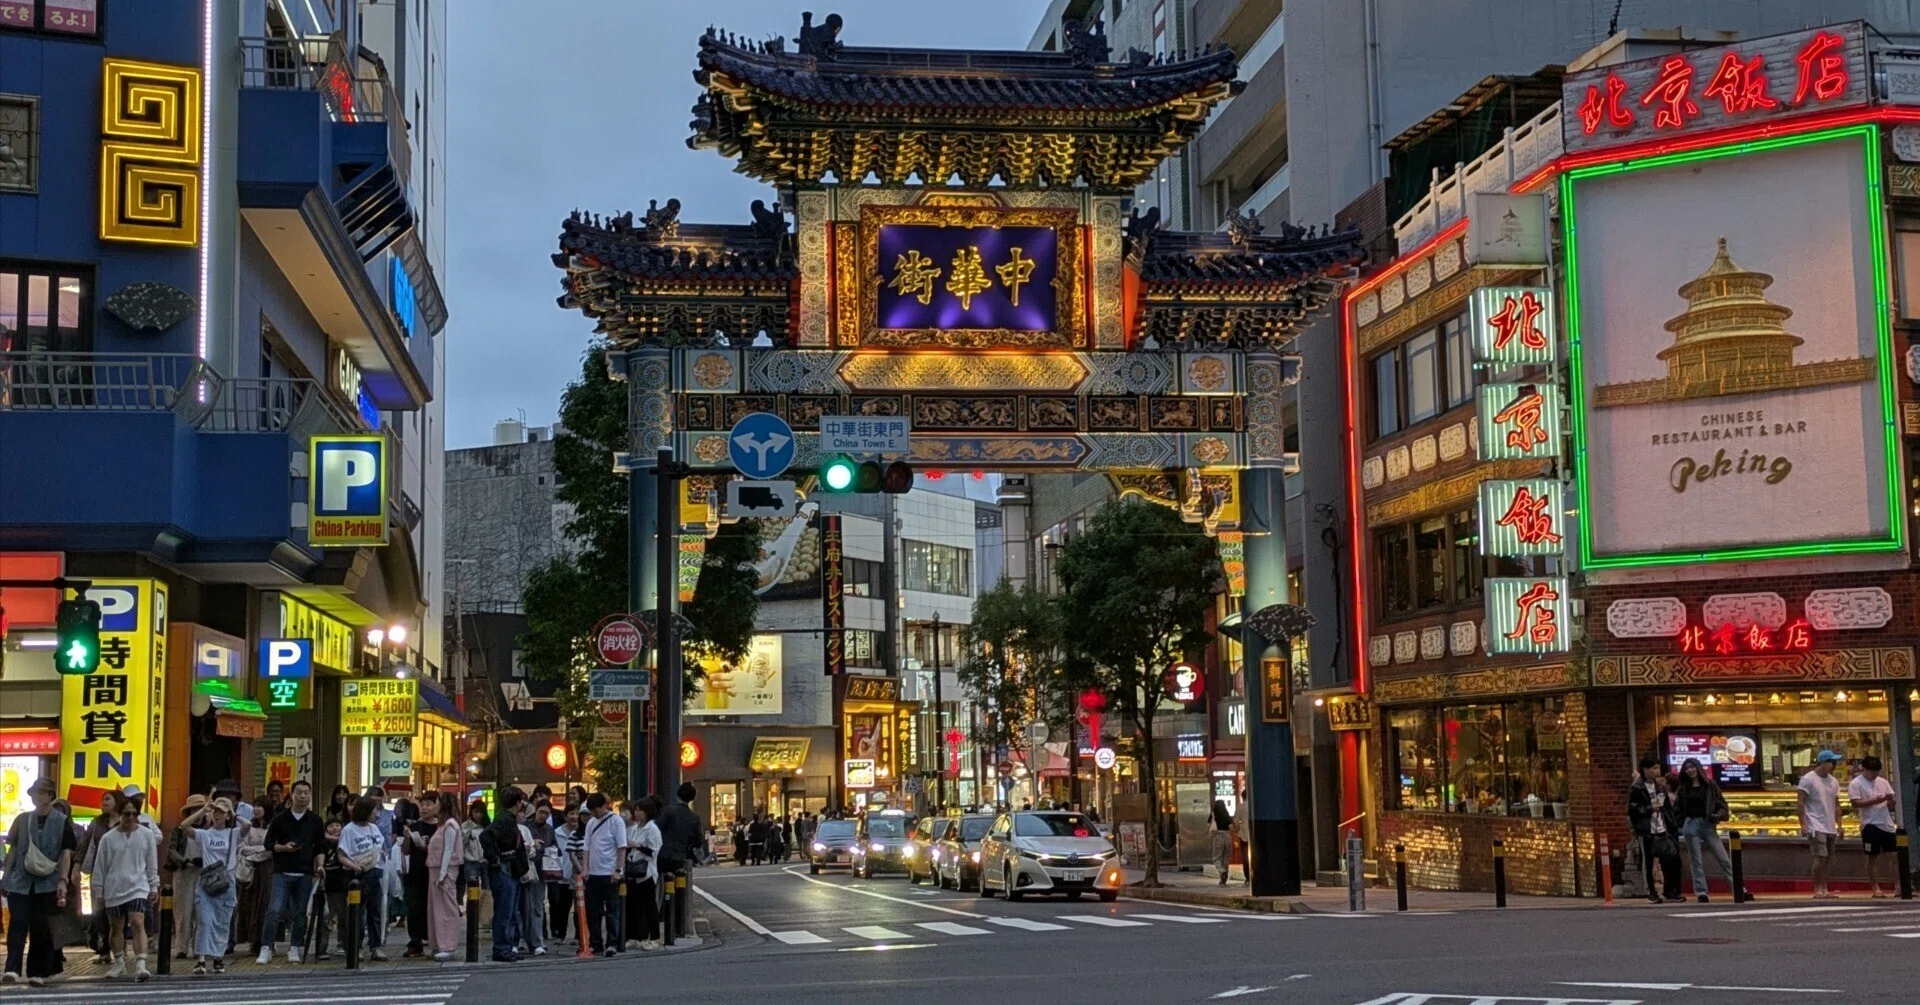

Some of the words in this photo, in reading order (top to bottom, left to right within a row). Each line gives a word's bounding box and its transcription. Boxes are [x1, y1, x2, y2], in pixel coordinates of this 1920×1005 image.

[1578, 34, 1848, 134] 北京飯店
[888, 246, 1036, 310] 中華街
[826, 421, 904, 437] 中華街東門
[1701, 410, 1764, 426] CHINESE
[833, 439, 858, 448] China
[862, 439, 885, 448] Town
[888, 440, 897, 448] E.
[1652, 426, 1753, 446] RESTAURANT
[1760, 425, 1770, 437] &
[1774, 420, 1807, 435] BAR
[322, 450, 376, 511] P
[1488, 291, 1564, 643] 北京飯店
[1669, 448, 1793, 494] Peking
[315, 520, 342, 537] China
[345, 521, 382, 538] Parking
[824, 530, 843, 667] 王府井レストラン
[603, 635, 638, 651] 消火栓
[1681, 620, 1809, 654] 北京飯店
[269, 641, 301, 676] P
[270, 679, 298, 706] 空
[345, 683, 358, 696] P
[360, 682, 414, 696] 時間貸駐車場
[74, 751, 133, 778] IN
[381, 760, 410, 769] GiGO
